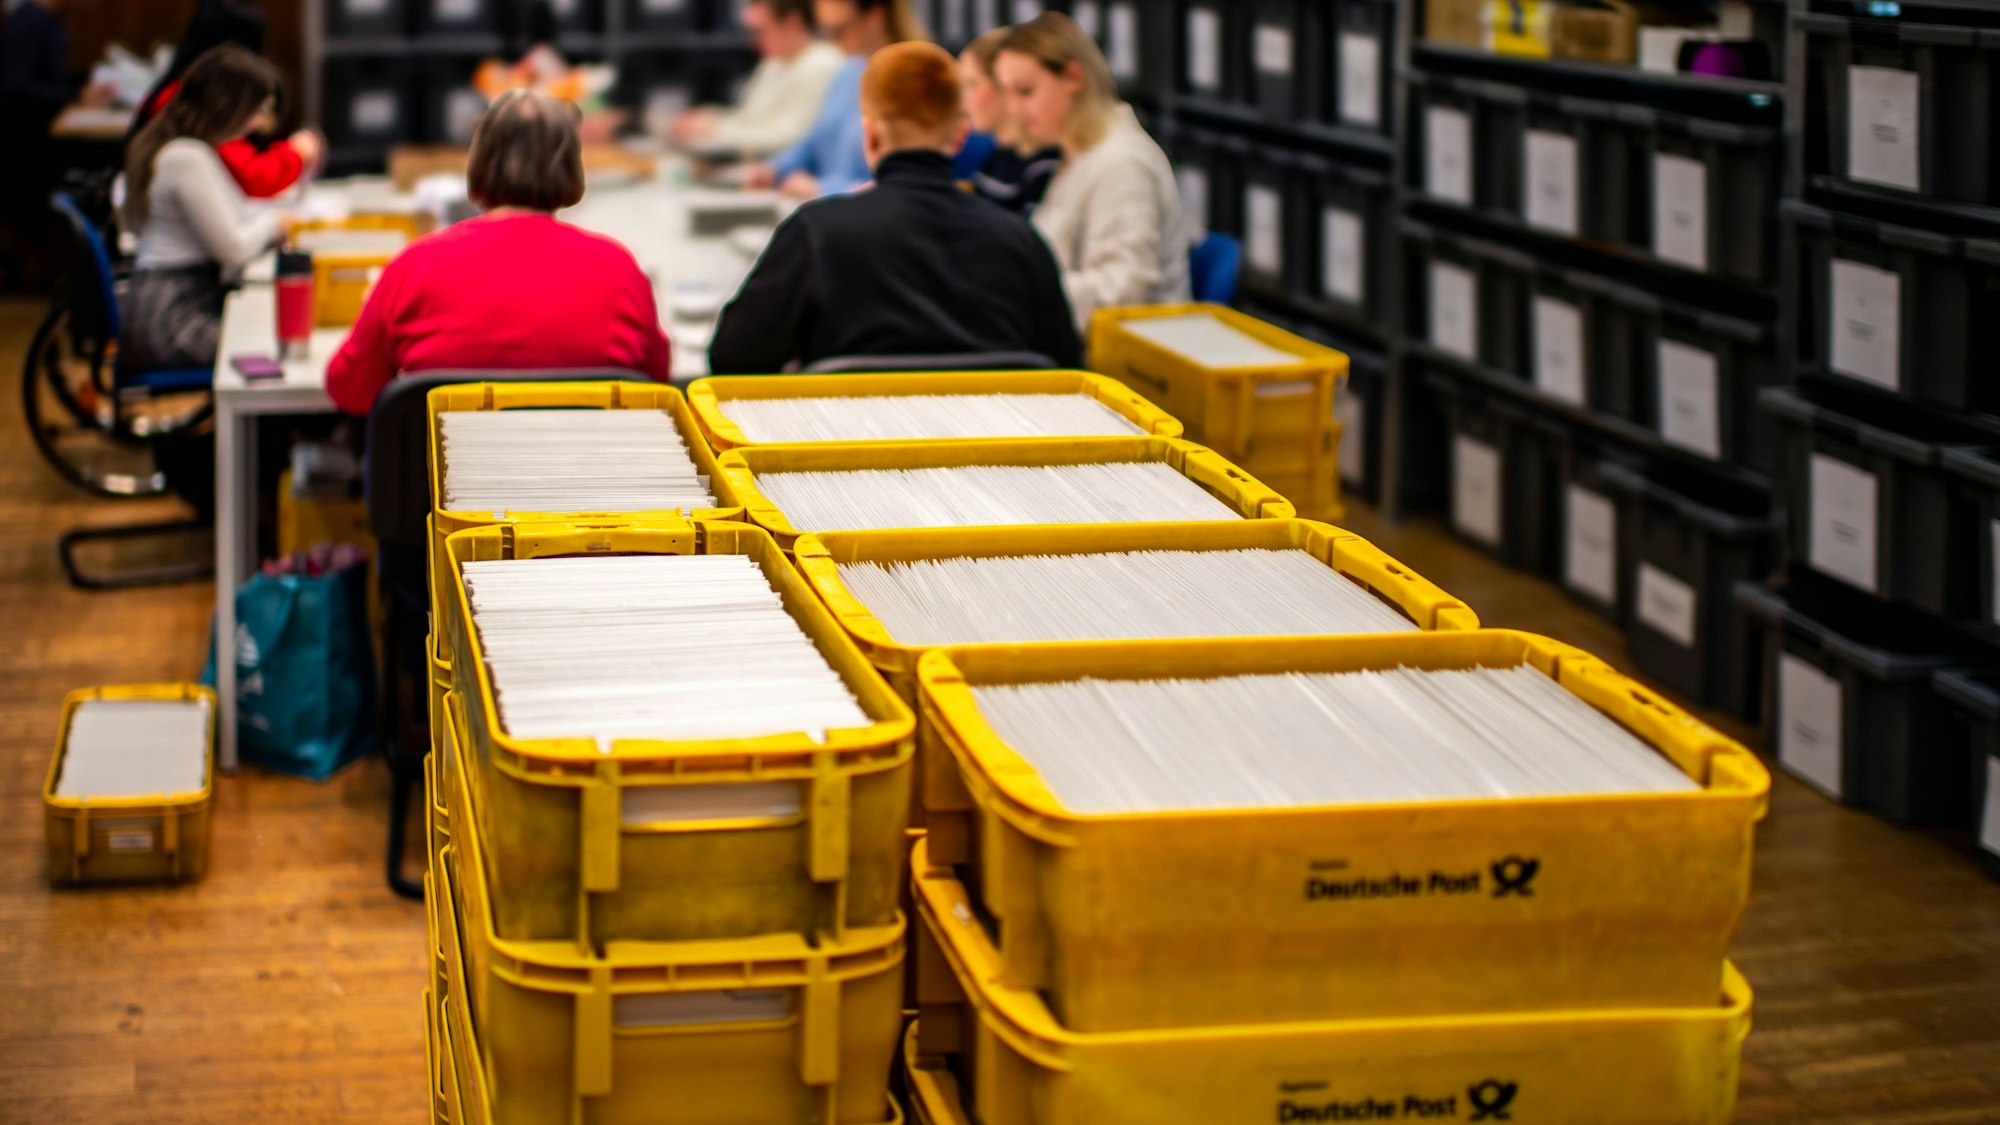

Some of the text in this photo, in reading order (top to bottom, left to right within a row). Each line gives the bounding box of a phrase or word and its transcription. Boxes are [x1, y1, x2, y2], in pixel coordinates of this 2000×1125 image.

[1306, 870, 1480, 900] Deutsche Post
[1278, 1095, 1457, 1124] Deutsche Post
